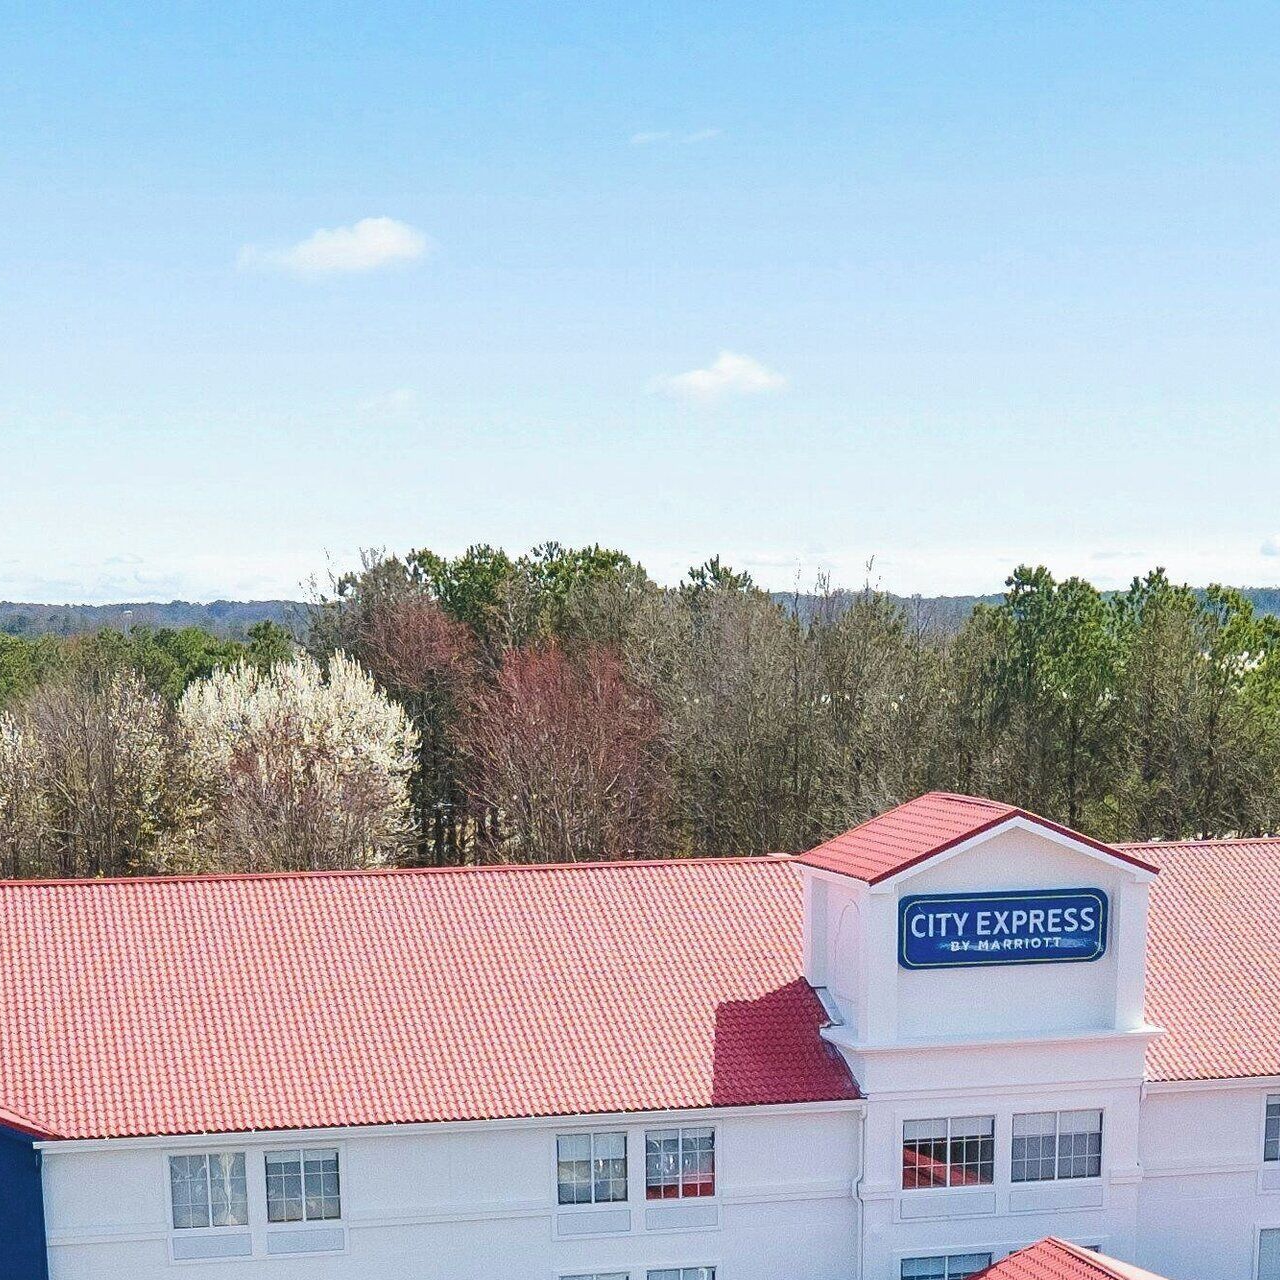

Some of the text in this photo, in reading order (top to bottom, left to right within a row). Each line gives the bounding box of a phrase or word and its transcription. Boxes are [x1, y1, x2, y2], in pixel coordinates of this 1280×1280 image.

[911, 907, 1095, 938] CITY EXPRESS
[950, 936, 1062, 952] BY MARRIOTT
